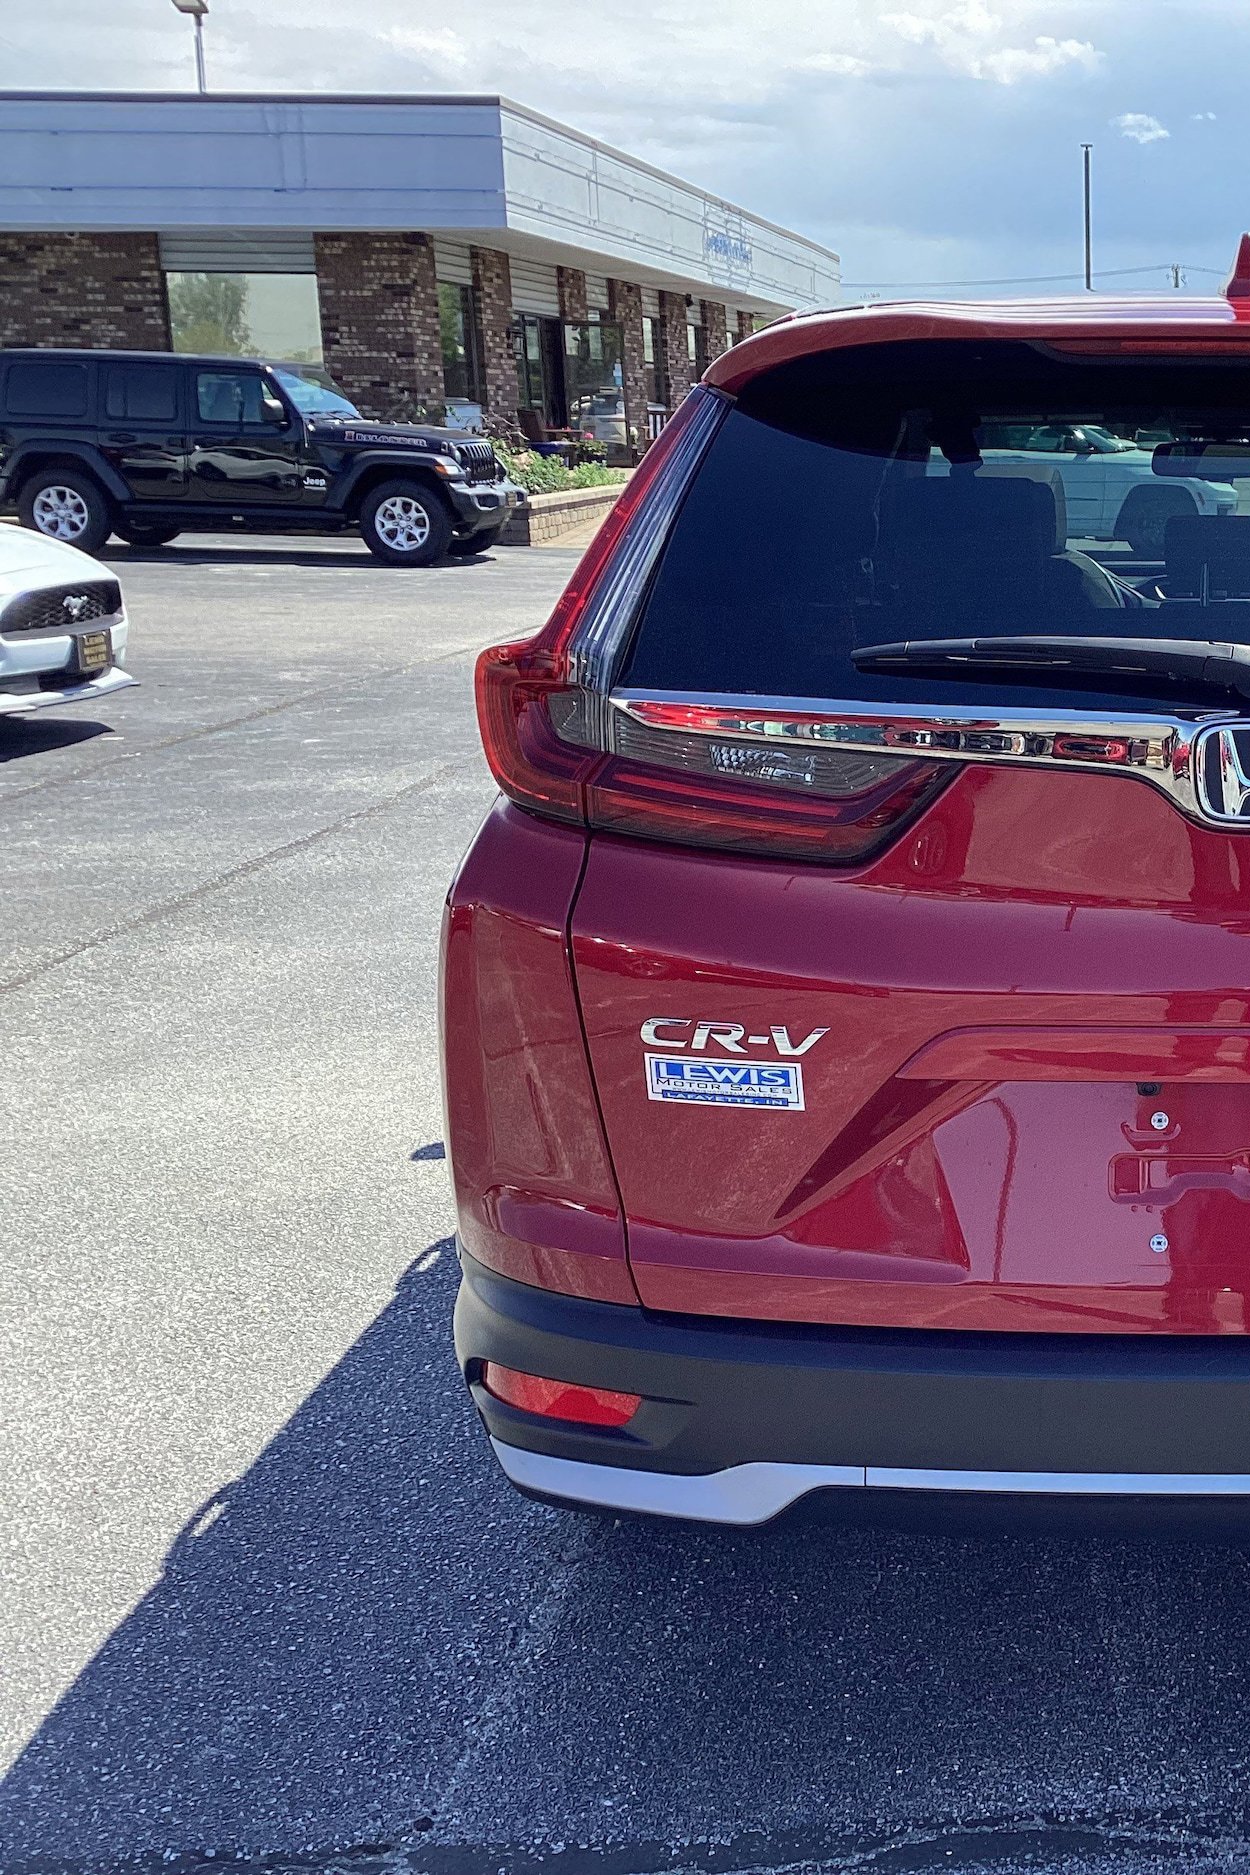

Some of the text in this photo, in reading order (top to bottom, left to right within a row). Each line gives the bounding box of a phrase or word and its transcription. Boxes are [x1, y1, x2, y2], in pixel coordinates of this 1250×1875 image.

[302, 476, 326, 487] Jeep
[640, 1017, 831, 1056] CR-V
[659, 1062, 786, 1086] LEWIS
[656, 1078, 792, 1095] MOTOR SALES
